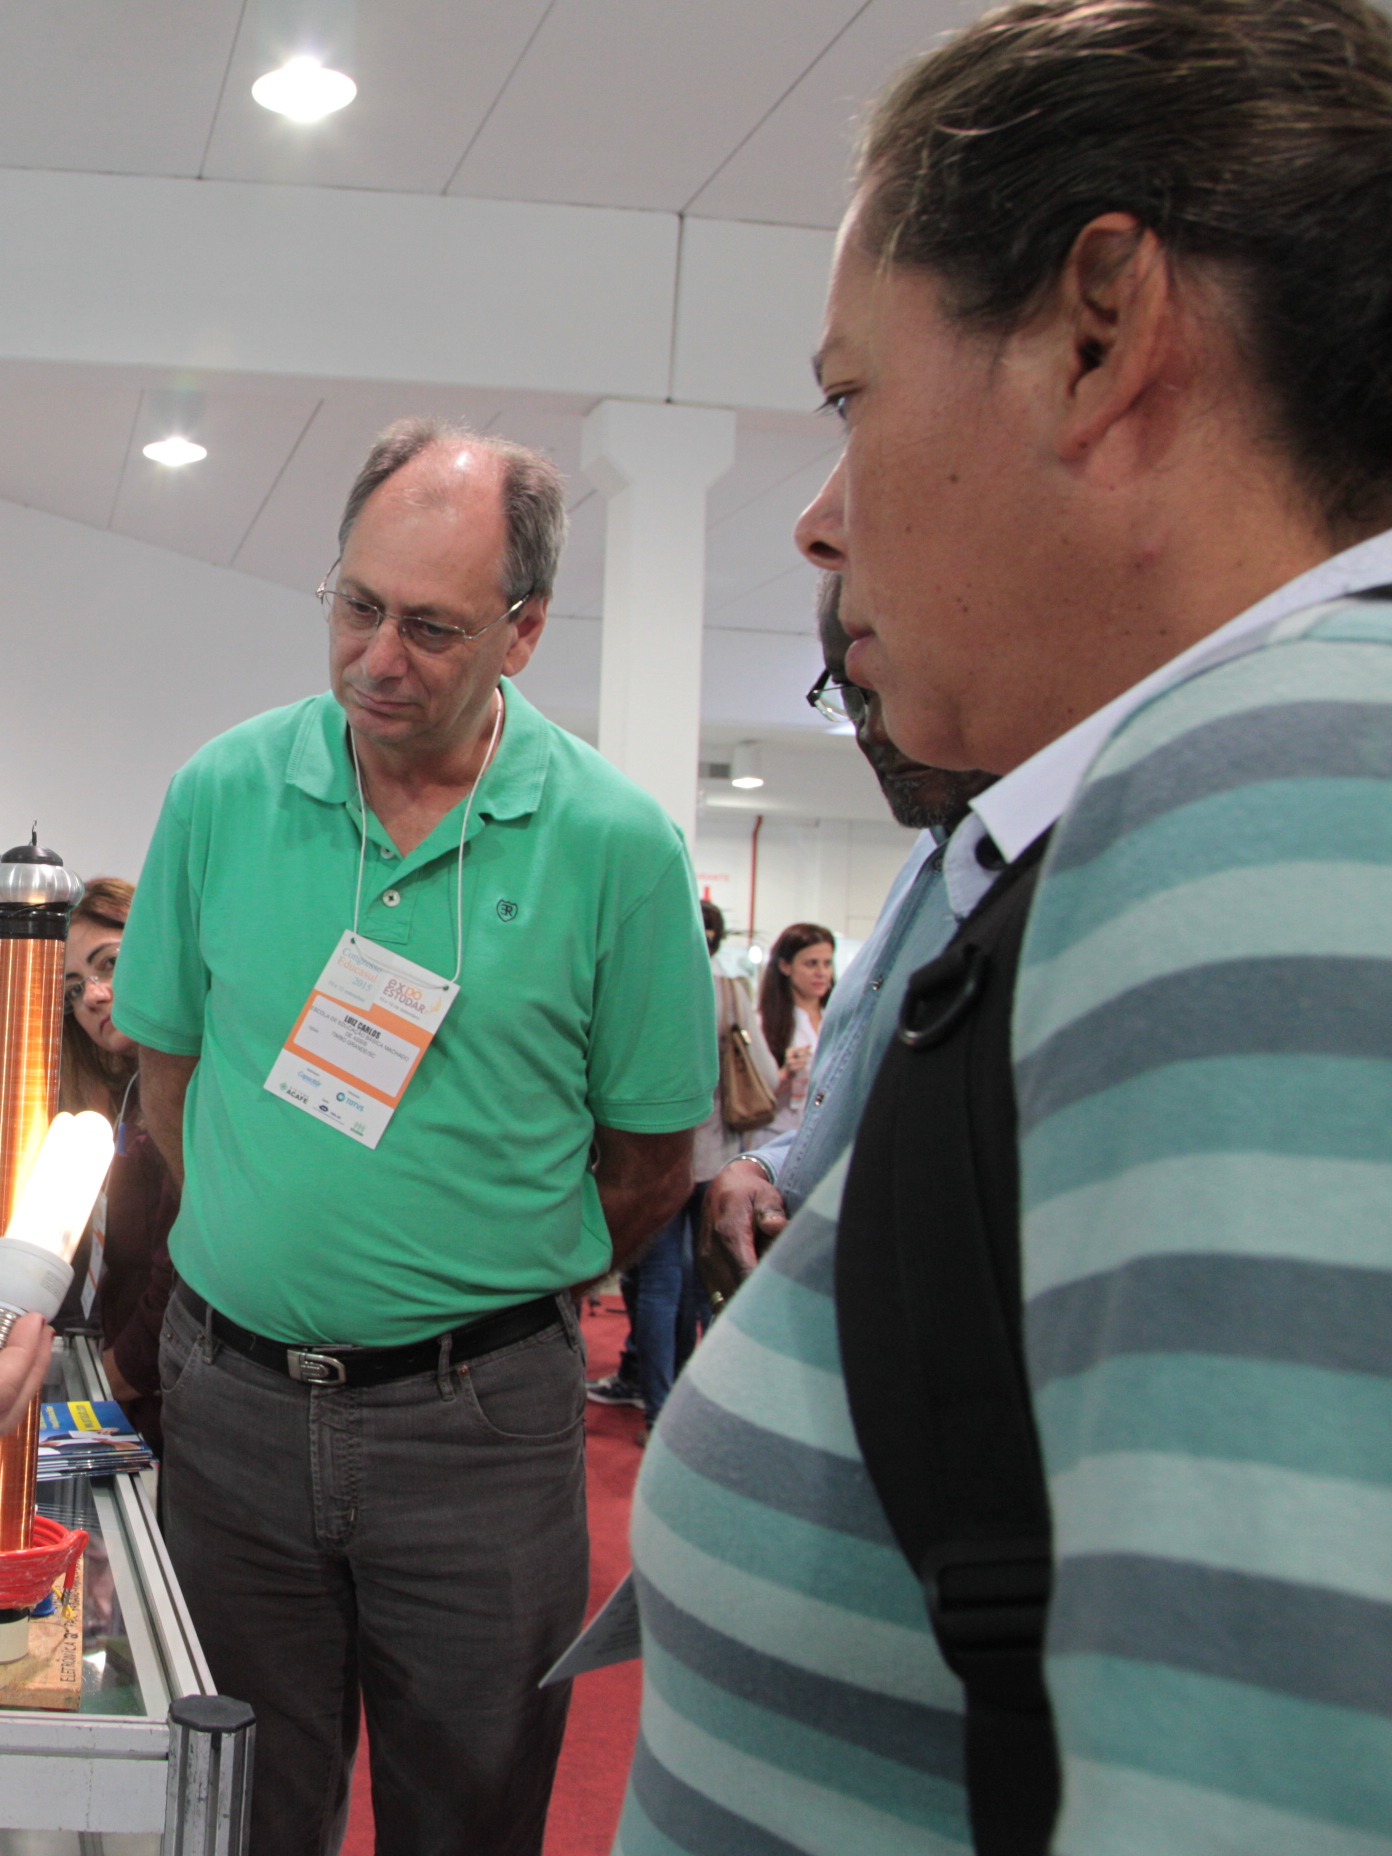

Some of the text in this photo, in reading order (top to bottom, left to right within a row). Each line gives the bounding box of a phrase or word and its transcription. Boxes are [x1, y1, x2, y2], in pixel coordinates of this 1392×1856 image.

[337, 956, 380, 982] Educasul
[342, 947, 383, 973] Congresso
[352, 976, 374, 992] 2015
[383, 986, 426, 1014] ESTUDAR
[344, 1015, 381, 1039] LUIZ CARLOS
[286, 1089, 308, 1104] ACAFE
